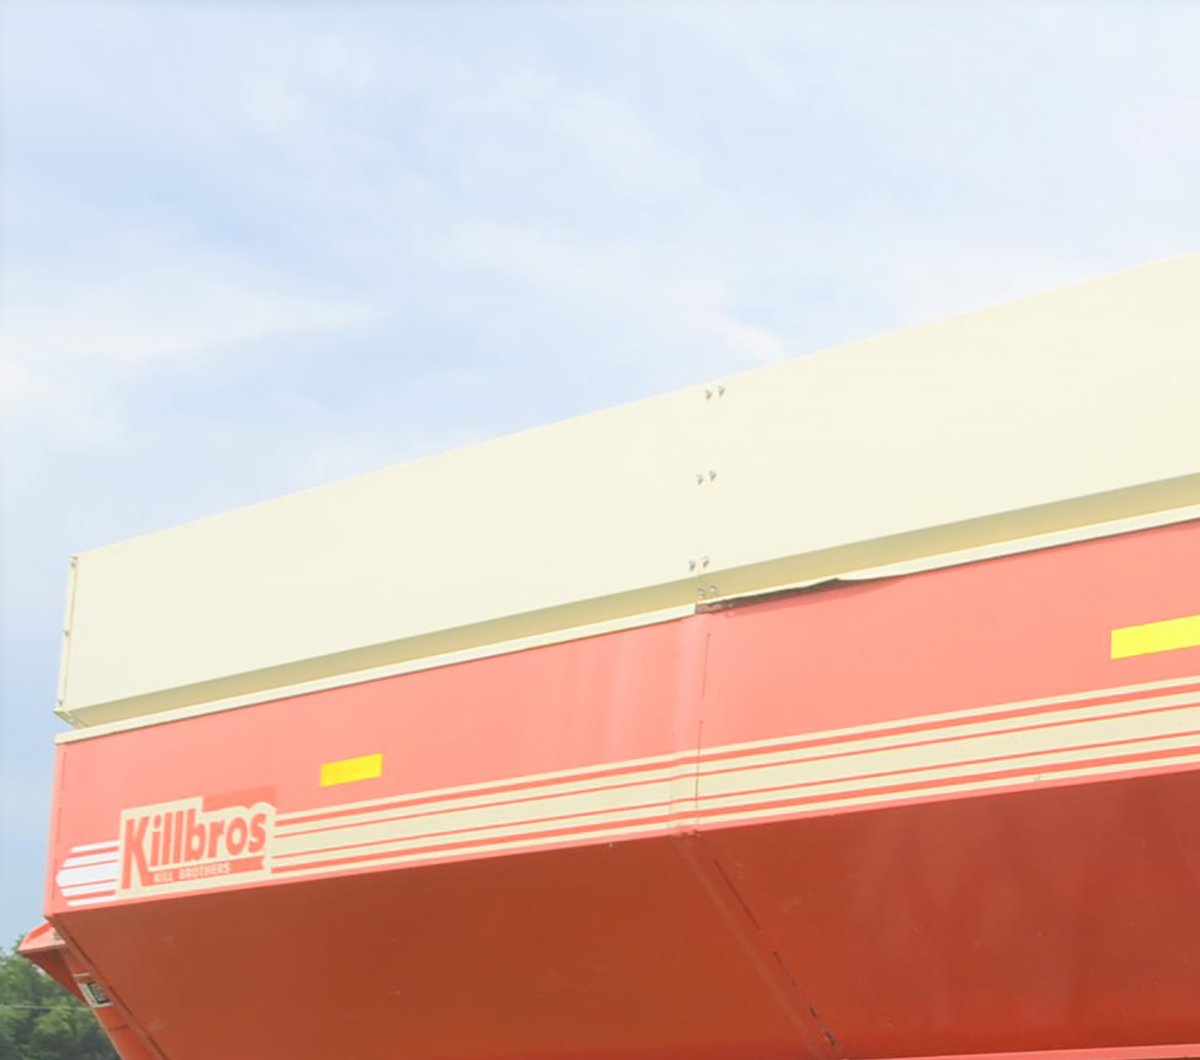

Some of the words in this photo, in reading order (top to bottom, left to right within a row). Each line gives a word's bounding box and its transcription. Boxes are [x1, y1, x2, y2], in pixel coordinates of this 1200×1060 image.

[121, 807, 267, 890] Killbros
[155, 869, 174, 884] KILL
[178, 862, 231, 881] BROTHERS
